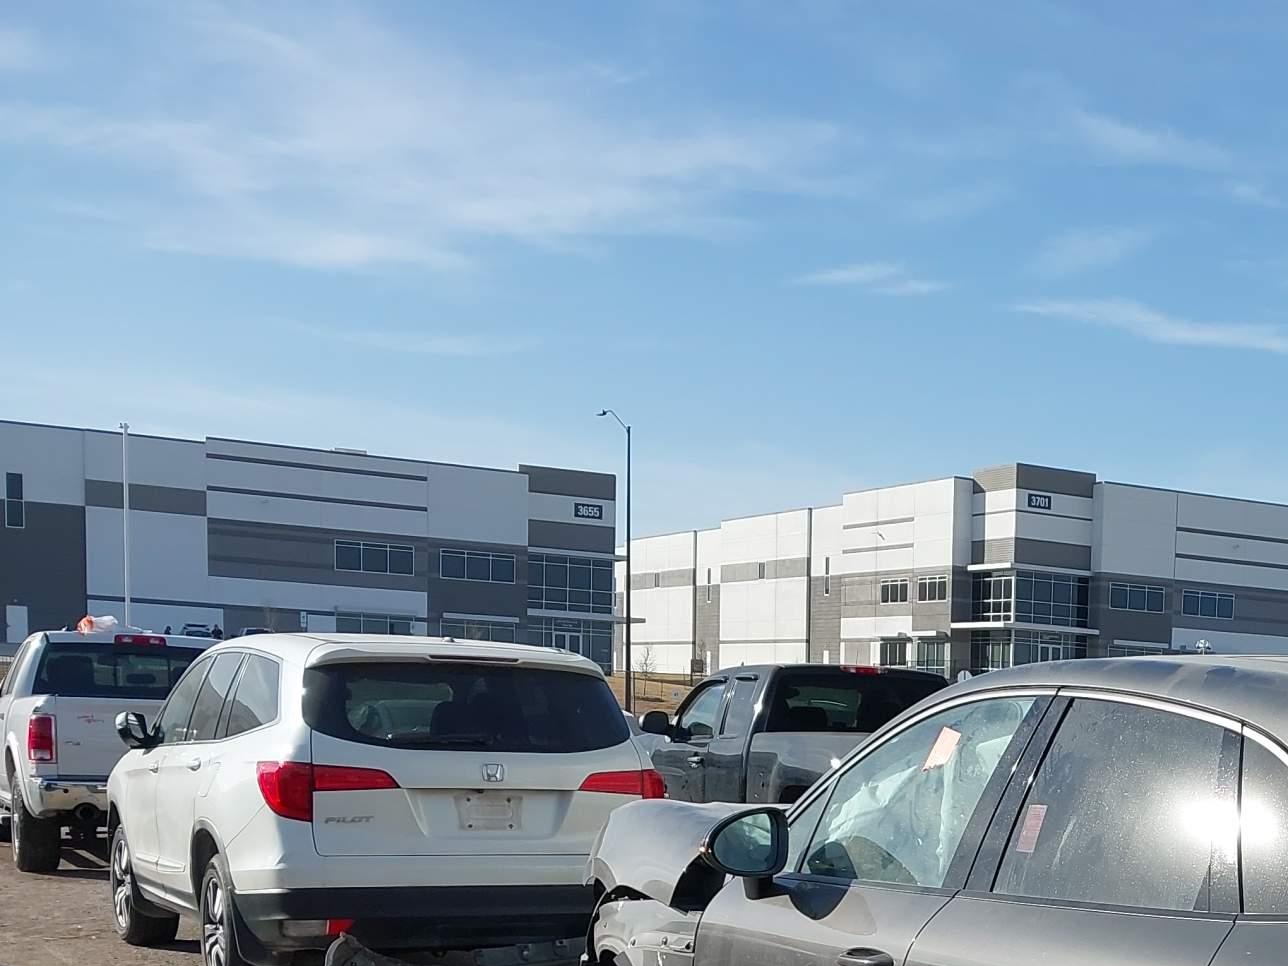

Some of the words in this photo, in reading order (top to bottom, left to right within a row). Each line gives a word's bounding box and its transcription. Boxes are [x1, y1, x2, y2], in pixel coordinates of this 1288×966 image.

[1030, 495, 1049, 508] 3701
[577, 505, 600, 518] 3655
[324, 816, 375, 824] PILOT
